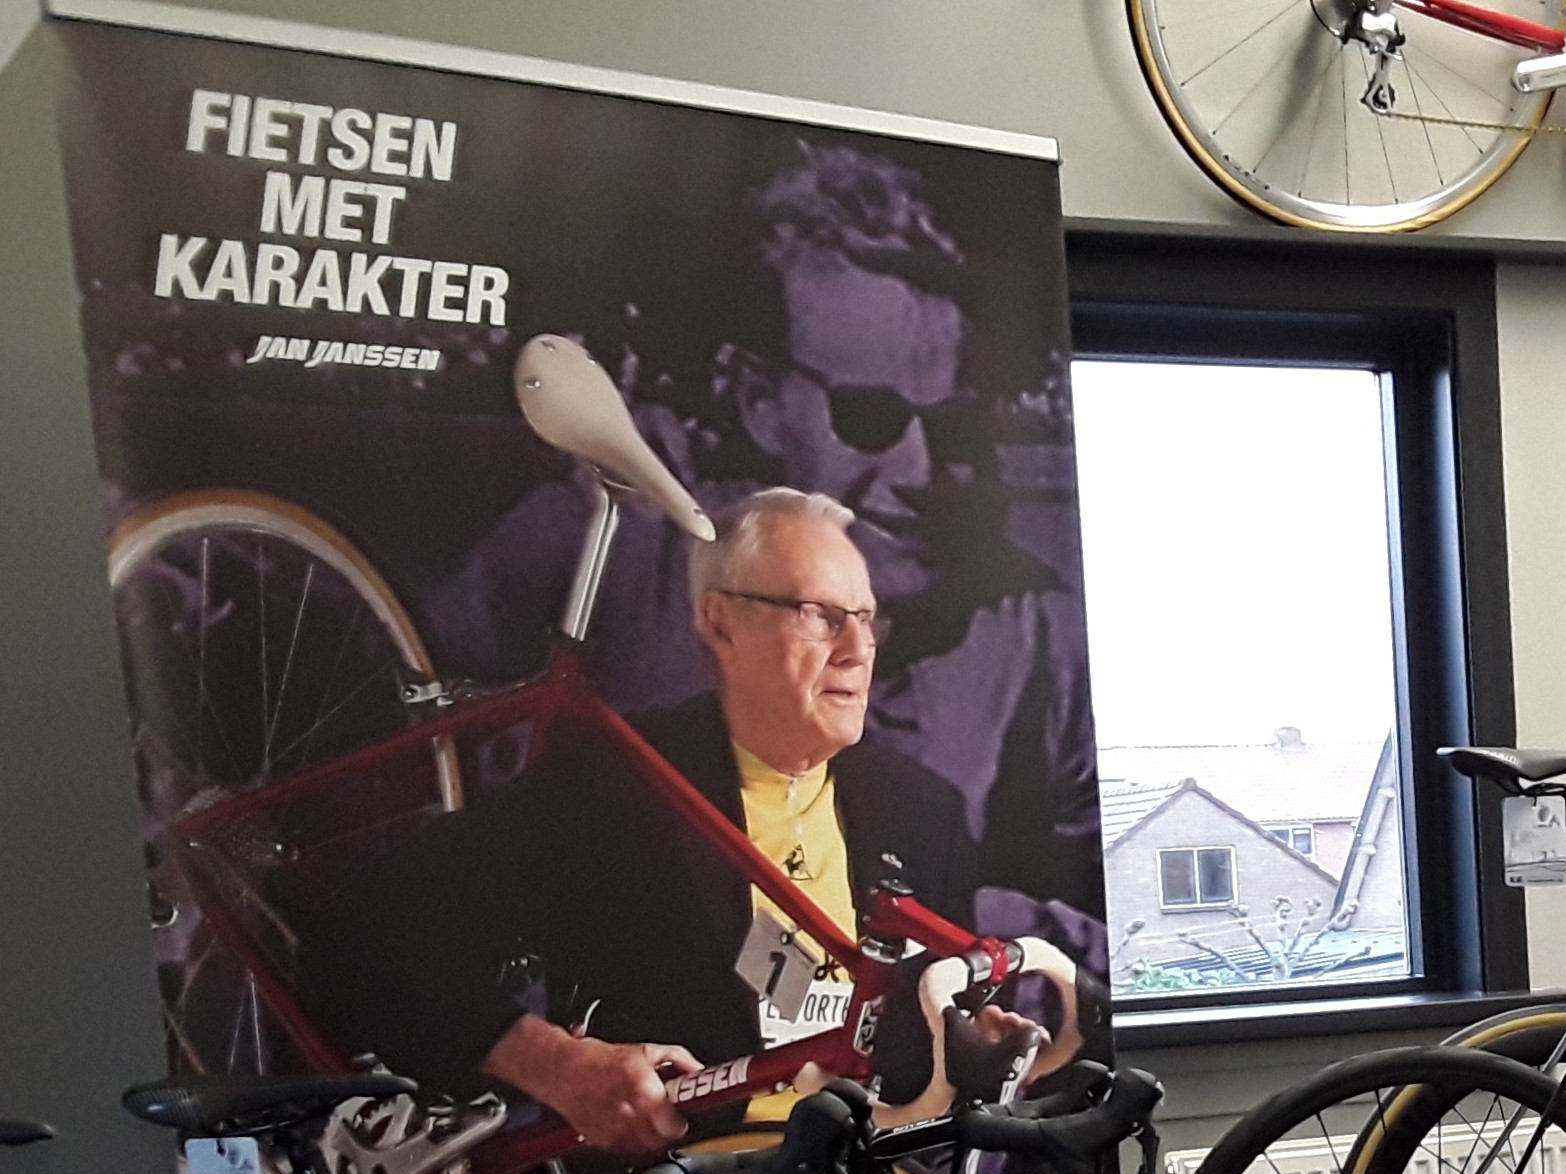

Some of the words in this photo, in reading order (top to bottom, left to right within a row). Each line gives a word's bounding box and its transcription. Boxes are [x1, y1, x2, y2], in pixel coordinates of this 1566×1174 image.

[185, 88, 457, 181] FIETSEN
[260, 170, 407, 244] MET
[154, 233, 510, 326] KARAKTER
[246, 335, 311, 364] JAN
[304, 340, 442, 371] JANSSEN
[767, 951, 788, 998] 1
